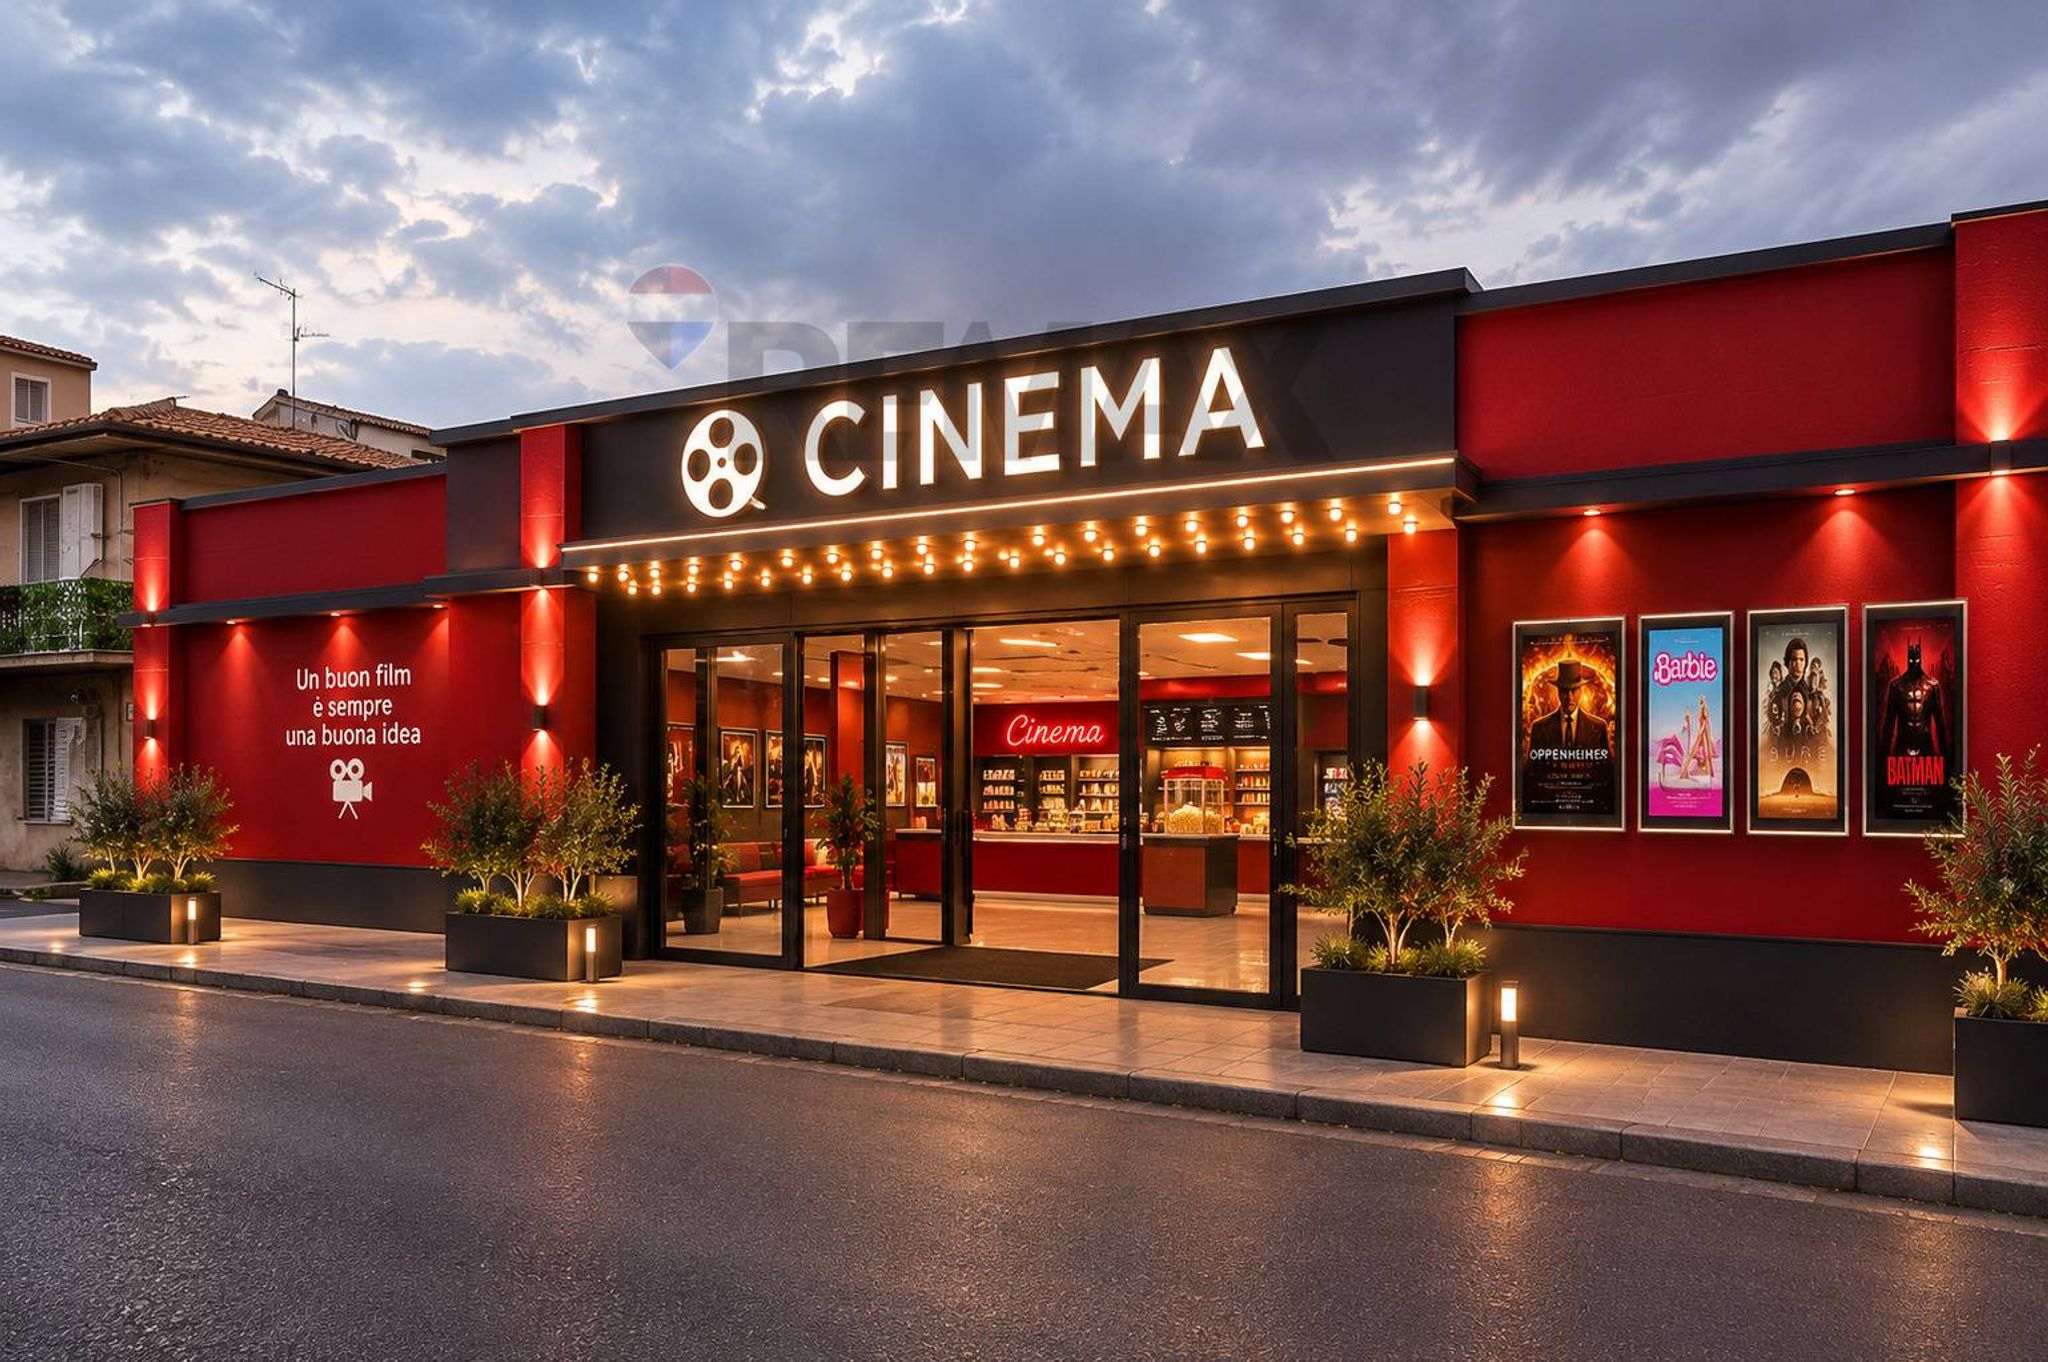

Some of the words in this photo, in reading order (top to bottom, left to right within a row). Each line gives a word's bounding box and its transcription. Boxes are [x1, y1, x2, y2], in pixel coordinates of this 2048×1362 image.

[804, 346, 1265, 497] CINEMA
[296, 668, 320, 691] Un
[325, 666, 370, 689] buon
[375, 663, 412, 688] film
[1653, 650, 1718, 685] Barbie
[327, 698, 393, 722] sempre
[285, 728, 316, 746] una
[321, 723, 377, 746] buona
[382, 722, 422, 745] idea
[1006, 714, 1105, 746] Cinema
[1887, 755, 1944, 786] BATMAN
